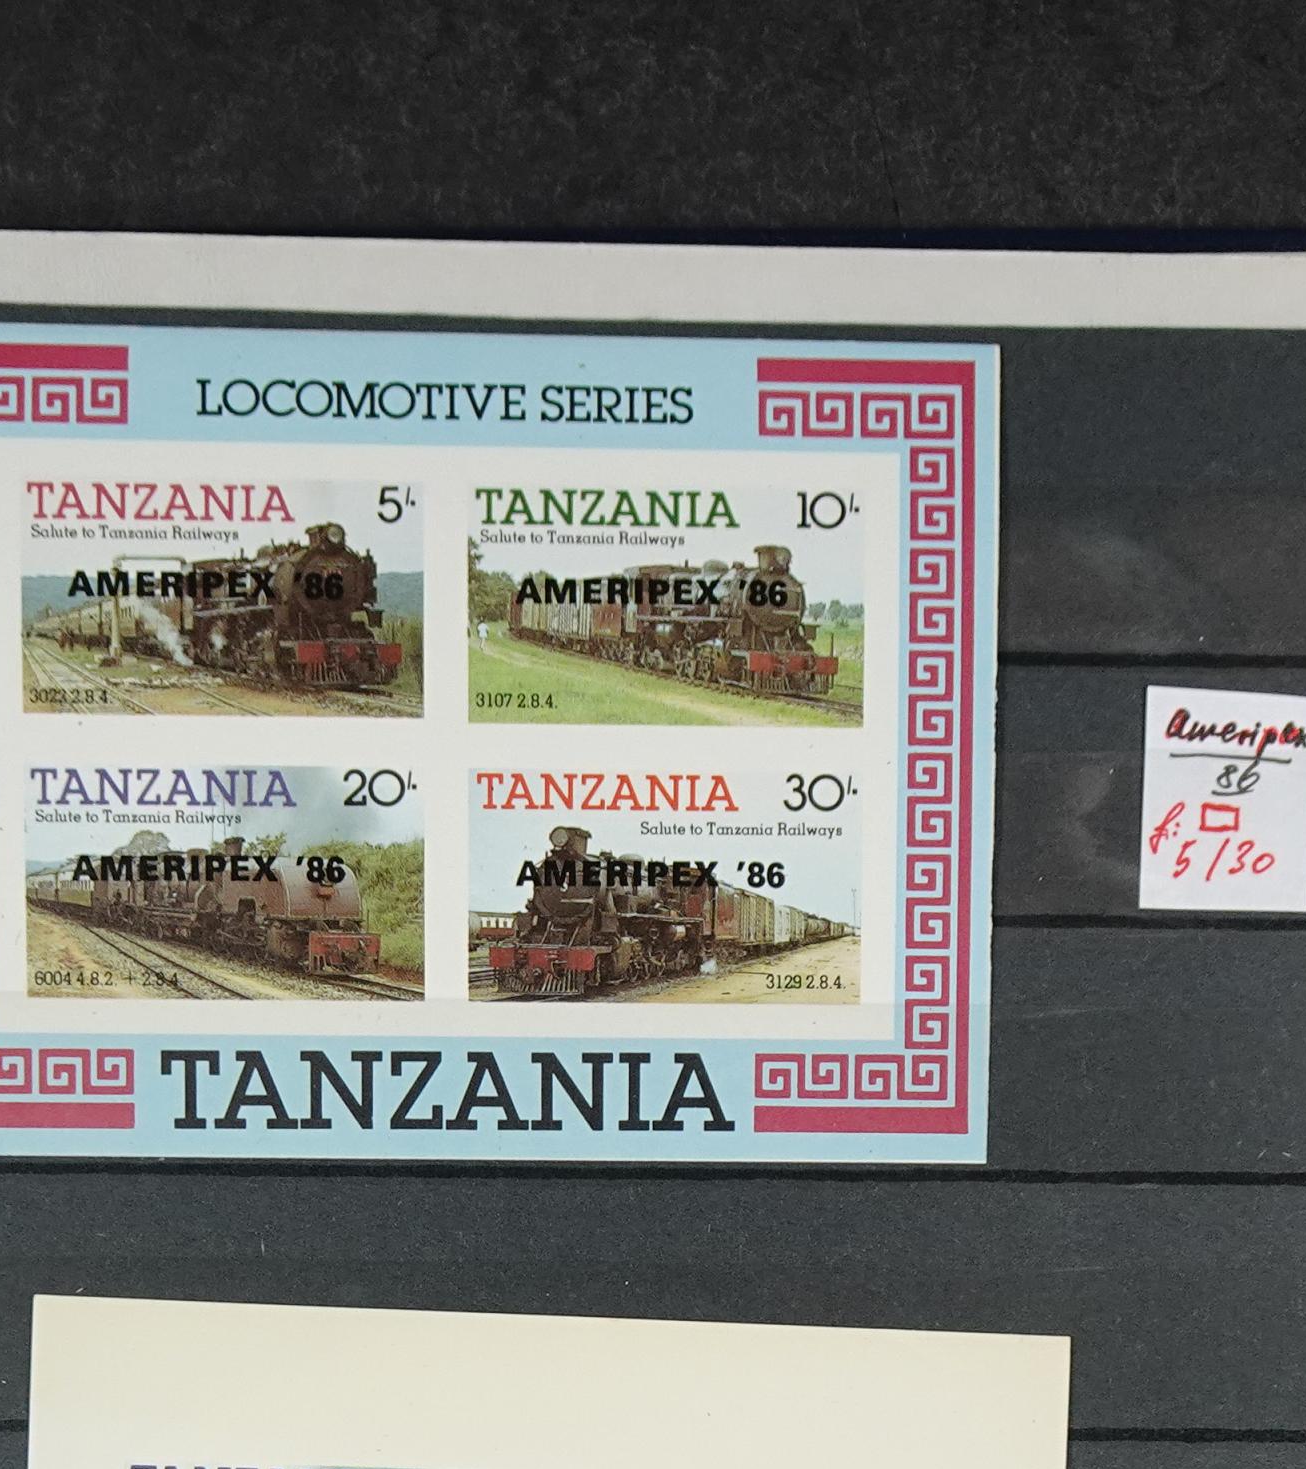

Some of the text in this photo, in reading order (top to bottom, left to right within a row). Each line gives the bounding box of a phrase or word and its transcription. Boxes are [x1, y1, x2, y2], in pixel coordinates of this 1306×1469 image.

[196, 379, 694, 425] LOCOMOTIVE SERIES
[27, 482, 294, 523] TANZANIA
[476, 488, 740, 528] TANZANIA
[31, 525, 239, 543] Salute to Tanzania Railways
[481, 529, 685, 548] Salute to Tanzania Railways
[68, 570, 274, 598] AMERIPEX
[516, 578, 720, 605] AMERIPEX
[476, 693, 512, 708] 3107
[31, 768, 297, 807] TANZANIA
[476, 773, 738, 812] TANZANIA
[1216, 764, 1260, 793] 86
[35, 809, 242, 825] Salute to Tanzania Railways
[641, 822, 842, 839] Salute to Tanzania Railways
[73, 854, 279, 883] AMERIPEX
[516, 860, 719, 888] AMERIPEX
[34, 972, 71, 986] 6004
[123, 973, 137, 986] +
[765, 974, 802, 990] 3129
[160, 1049, 735, 1131] TANZANIA
